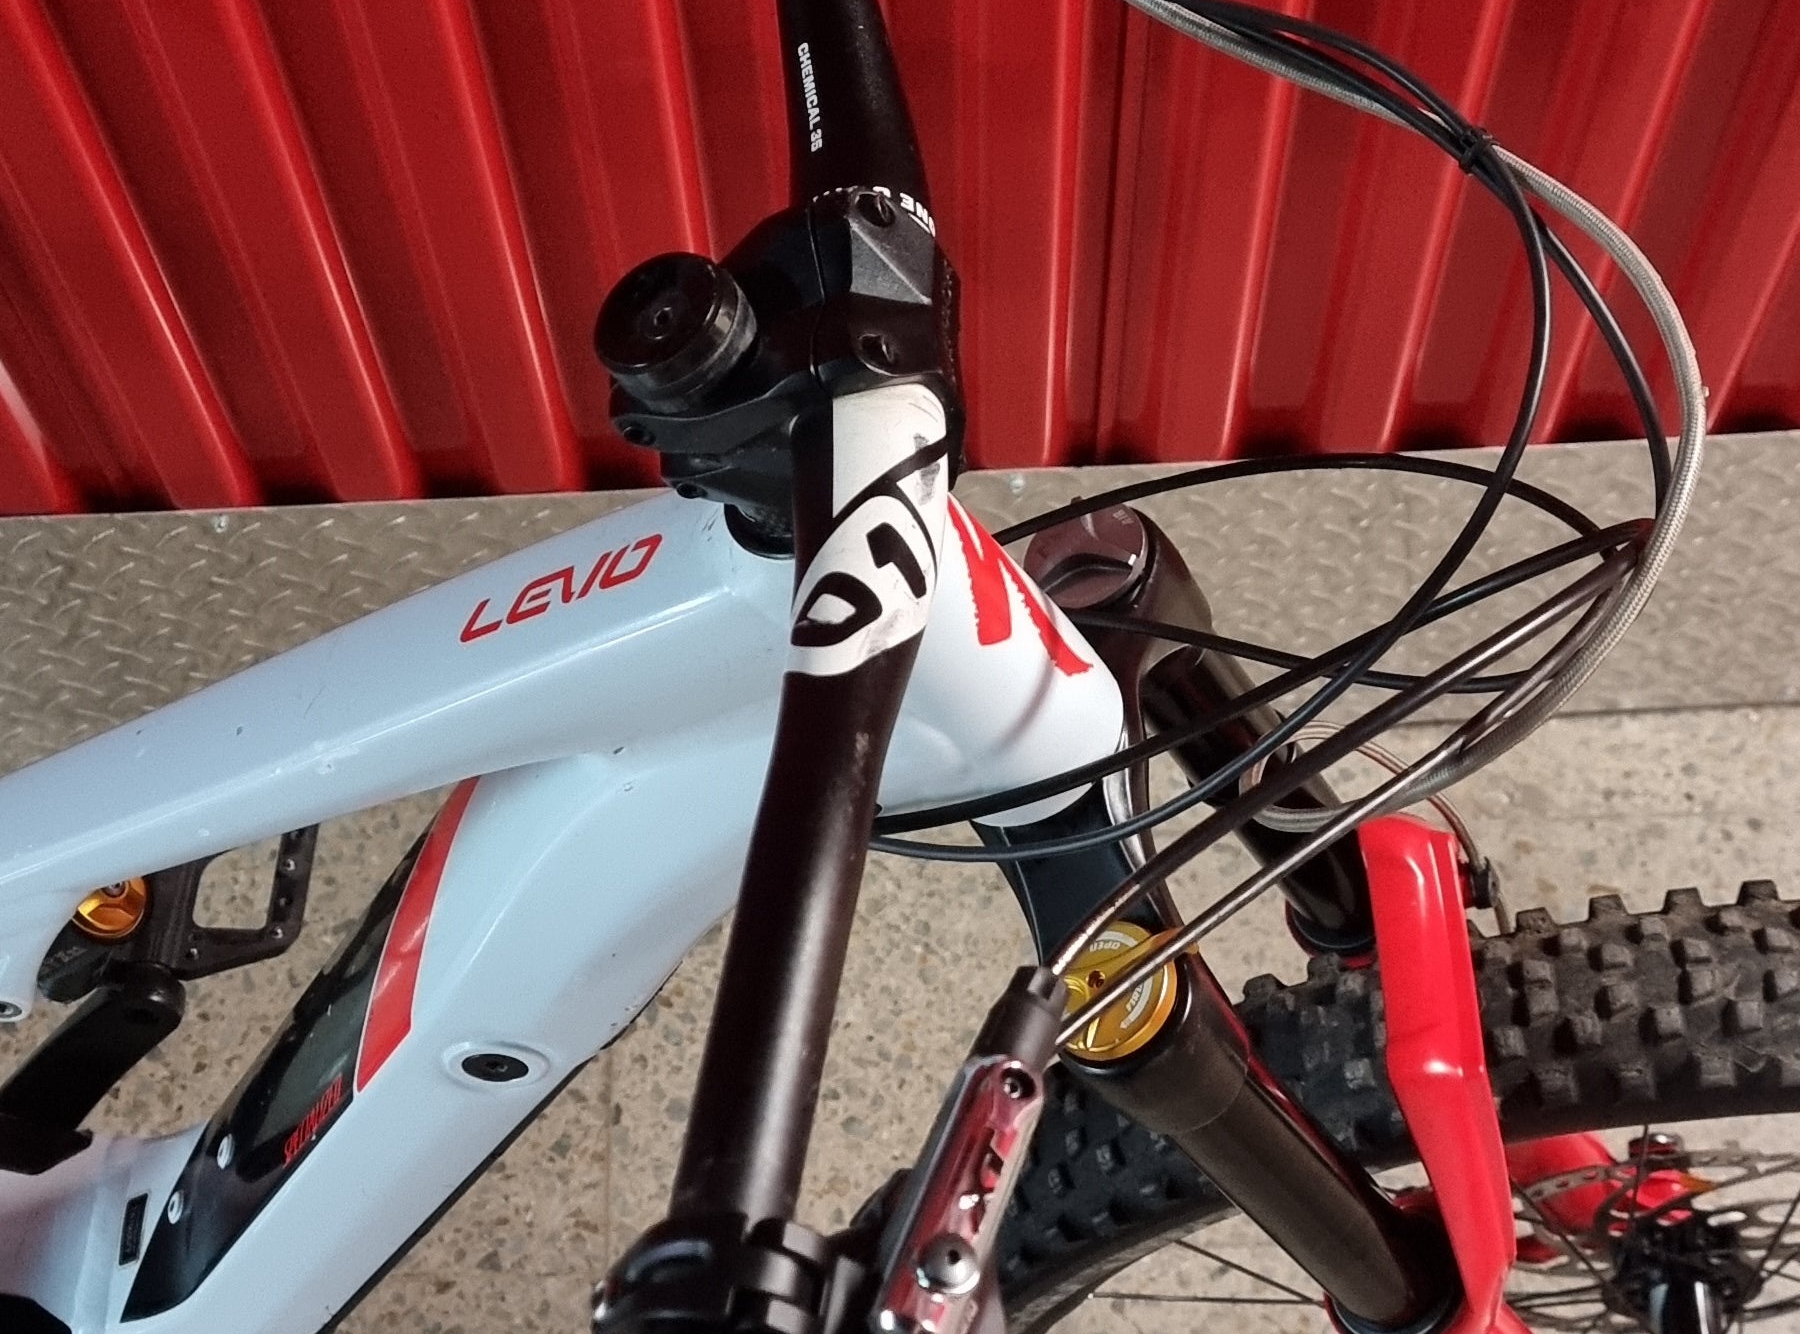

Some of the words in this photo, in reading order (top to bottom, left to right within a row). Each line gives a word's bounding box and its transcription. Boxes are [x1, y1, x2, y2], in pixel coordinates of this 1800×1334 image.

[797, 42, 821, 131] CHEMICAL
[810, 128, 823, 153] 35
[459, 533, 663, 643] LEVO
[1089, 940, 1120, 953] OPEN
